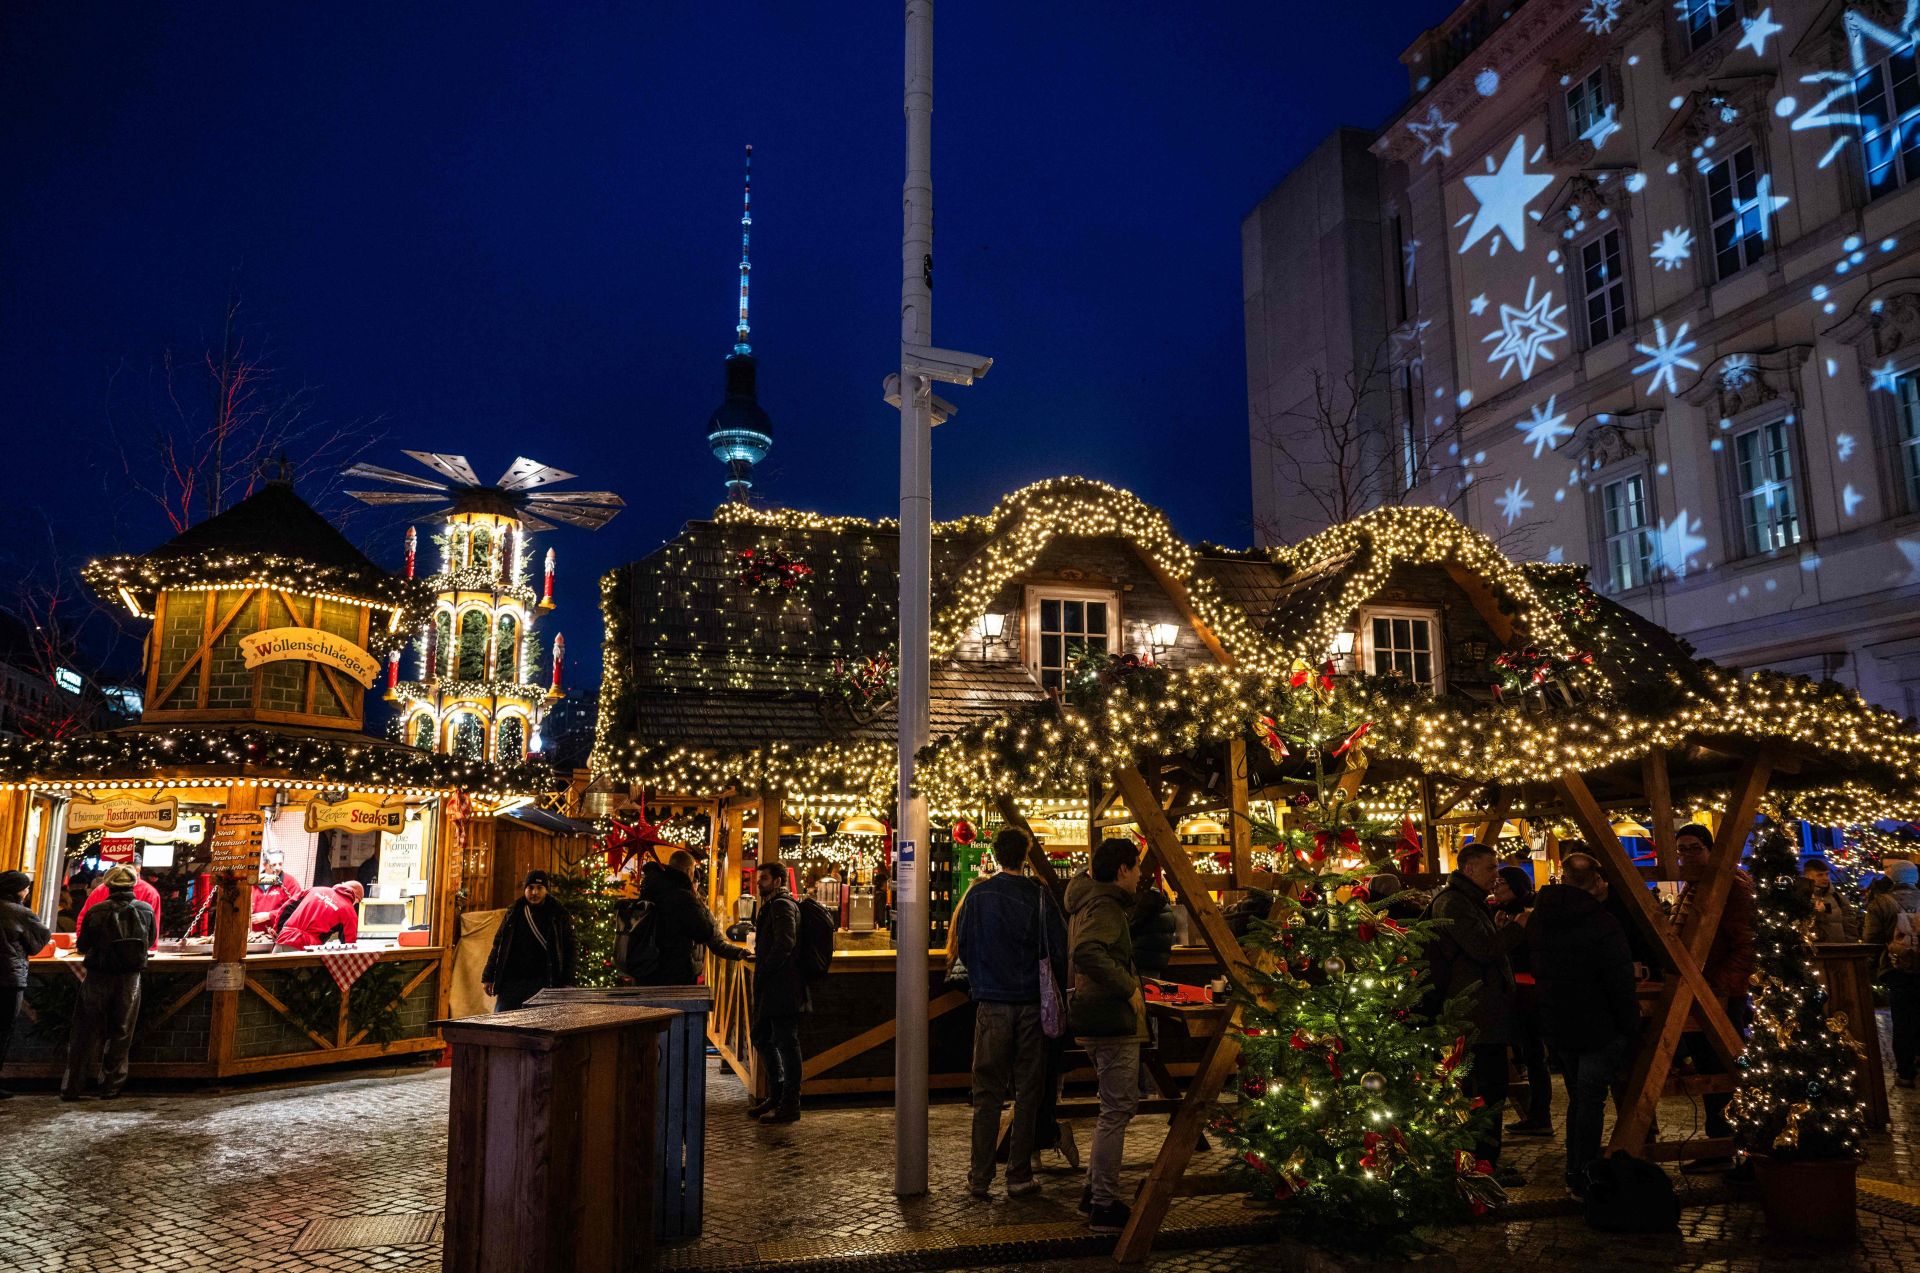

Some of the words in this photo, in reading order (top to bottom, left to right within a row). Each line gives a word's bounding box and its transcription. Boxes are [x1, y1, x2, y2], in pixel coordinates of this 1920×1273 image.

[255, 638, 366, 674] Wollenschlaeger
[102, 799, 132, 810] ORIGINAL
[73, 810, 105, 823] Thüringer
[107, 808, 158, 821] Rostbratwurst
[351, 809, 387, 826] Steaks
[101, 843, 134, 854] Kasse
